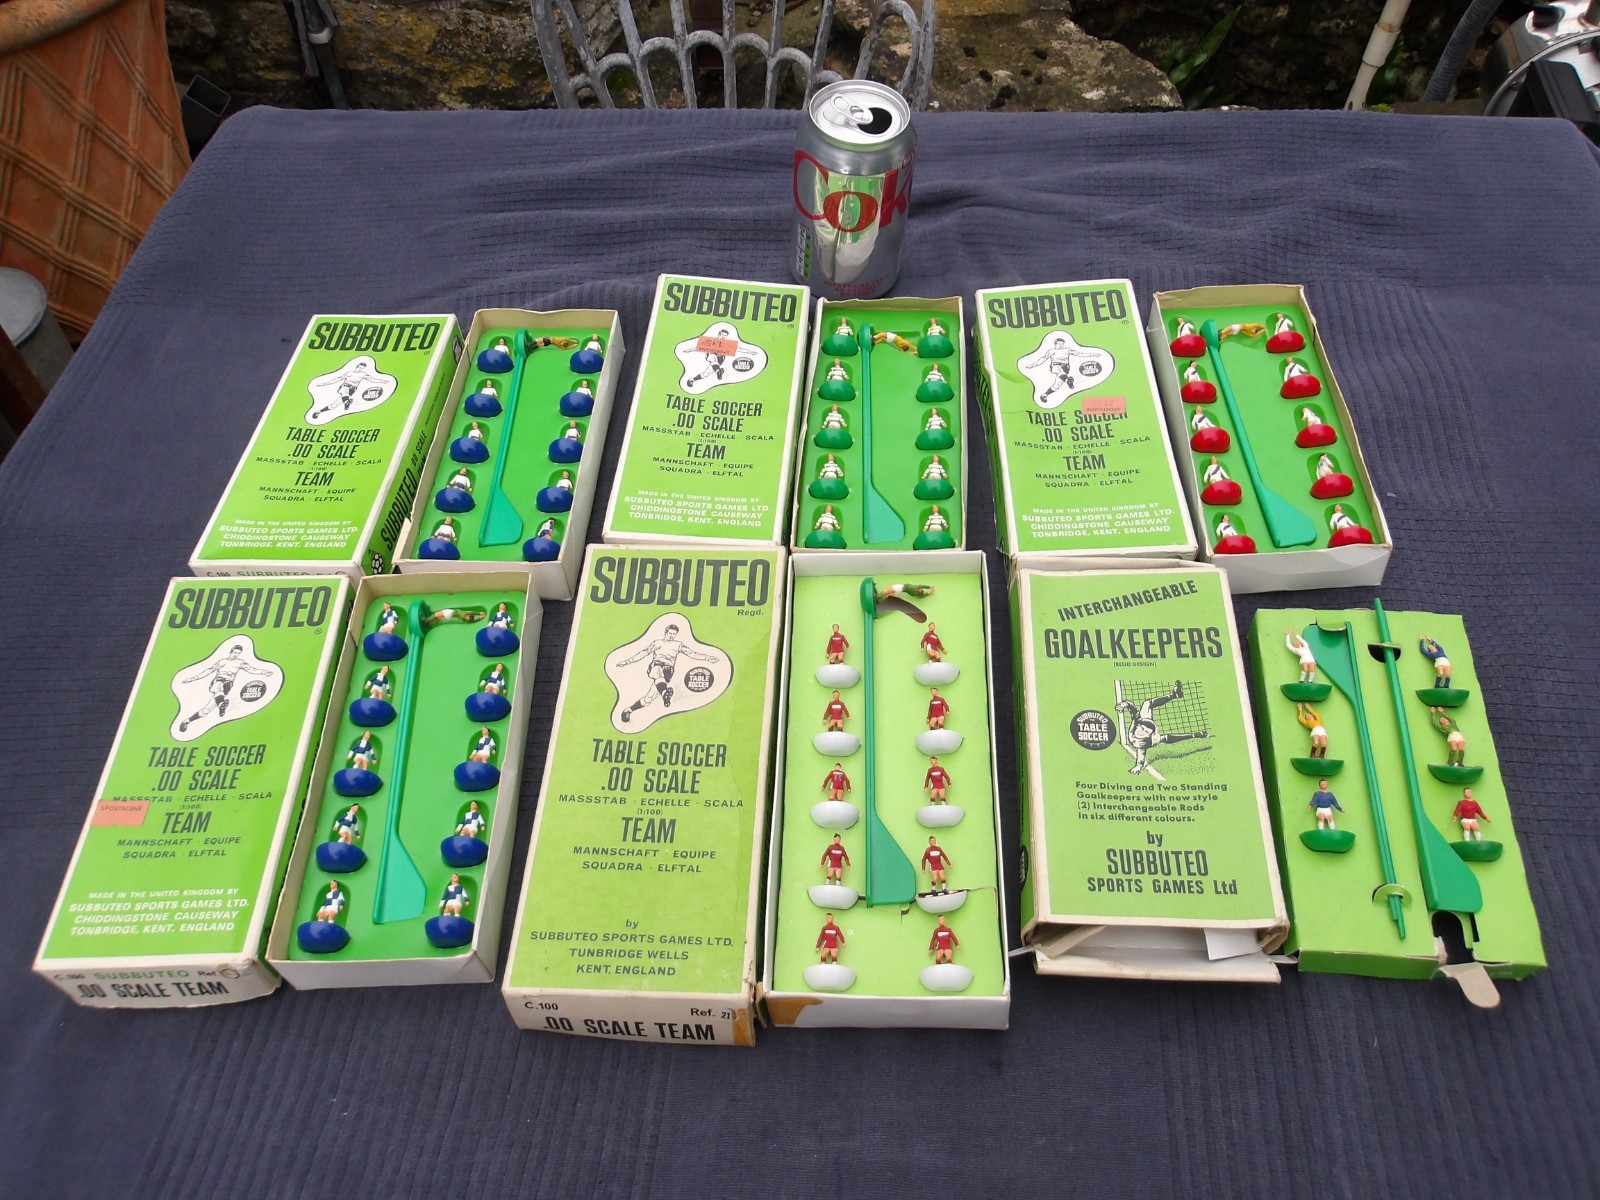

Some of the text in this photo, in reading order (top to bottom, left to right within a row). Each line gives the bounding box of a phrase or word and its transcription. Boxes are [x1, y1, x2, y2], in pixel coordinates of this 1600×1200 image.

[664, 283, 797, 323] SUBBUTEO
[988, 289, 1127, 328] SUBBUTEO
[308, 322, 440, 352] SUBBUTEO
[666, 394, 762, 417] TABLE SOCCER
[702, 416, 744, 432] SCALE
[1026, 410, 1067, 426] TABLE
[286, 427, 380, 443] TABLE SOCCER
[642, 425, 691, 436] MASSSTAB
[1071, 423, 1114, 442] SCALE
[1014, 441, 1063, 450] MASSSTAB
[1120, 436, 1151, 445] SCALA
[317, 445, 359, 458] SCALE
[687, 443, 726, 459] TEAM
[256, 457, 304, 465] MASSSTAB
[653, 457, 713, 467] MANNSCHAFT
[1063, 454, 1106, 471] TEAM
[660, 466, 702, 474] SQUADRA
[1108, 469, 1140, 477] EQUIPE
[295, 472, 334, 486] TEAM
[624, 496, 673, 506] SUBBUTEO
[715, 503, 748, 511] GAMES
[631, 505, 763, 519] CHIDDINGSTONE CAUSEWAY
[1116, 511, 1150, 519] GAMES
[718, 518, 762, 527] ENGLAND
[1031, 518, 1168, 530] CHIDDINGSTONE CAUSEWAY
[1125, 526, 1171, 534] ENGLAND
[590, 556, 771, 607] SUBBUTEO
[168, 586, 331, 629] SUBBUTEO
[1058, 580, 1198, 622] INTERCHANGEABLE
[1044, 627, 1223, 659] GOALKEEPERS
[1077, 711, 1108, 723] SUBBUTEO
[1078, 723, 1108, 731] TABLE
[1078, 732, 1108, 741] SOCCER
[148, 744, 266, 767] TABLE SOCCER
[592, 738, 727, 767] TABLE SOCCER
[189, 769, 241, 791] SCALE
[644, 769, 701, 794] SCALE
[1075, 781, 1097, 789] Four
[1100, 783, 1132, 792] Diving
[1135, 783, 1154, 791] and
[1181, 783, 1227, 791] Standing
[184, 794, 228, 802] ECHELLE
[559, 794, 744, 807] MASSSTAB ECHELLE SCALA
[1077, 792, 1140, 801] Goalkeepers
[1193, 794, 1218, 802] style
[1078, 801, 1090, 810] (2)
[1093, 802, 1177, 812] Interchangeable
[162, 811, 212, 834] TEAM
[1108, 813, 1152, 822] different
[622, 817, 677, 844] TEAM
[1146, 831, 1163, 847] by
[123, 851, 176, 859] SQUADRA
[573, 846, 716, 859] MANNSCHAFT EQUIPE
[582, 861, 702, 872] SQUADRA ELFTAL
[1106, 848, 1208, 876] SUBBUTEO
[1087, 877, 1238, 894] SPORTS GAMES Ltd
[69, 899, 249, 912] SUBBUTEO SPORTS GAMES LTD.
[74, 910, 239, 923] CHIDDINGSTONE CAUSEWAY
[180, 922, 235, 932] ENGLAND
[626, 919, 639, 929] by
[530, 931, 733, 946] SUBBUTEO SPORTS GAMES LTD.
[570, 948, 689, 960] TUNBRIDGE WELLS
[94, 970, 189, 980] SUBBUTEO
[576, 964, 676, 976] KENT, ENGLAND
[111, 981, 229, 998] SCALE TEAM
[524, 1002, 558, 1011] C.100
[691, 1008, 715, 1017] Ref.
[584, 1019, 648, 1038] SCALE
[654, 1022, 716, 1041] TEAM
